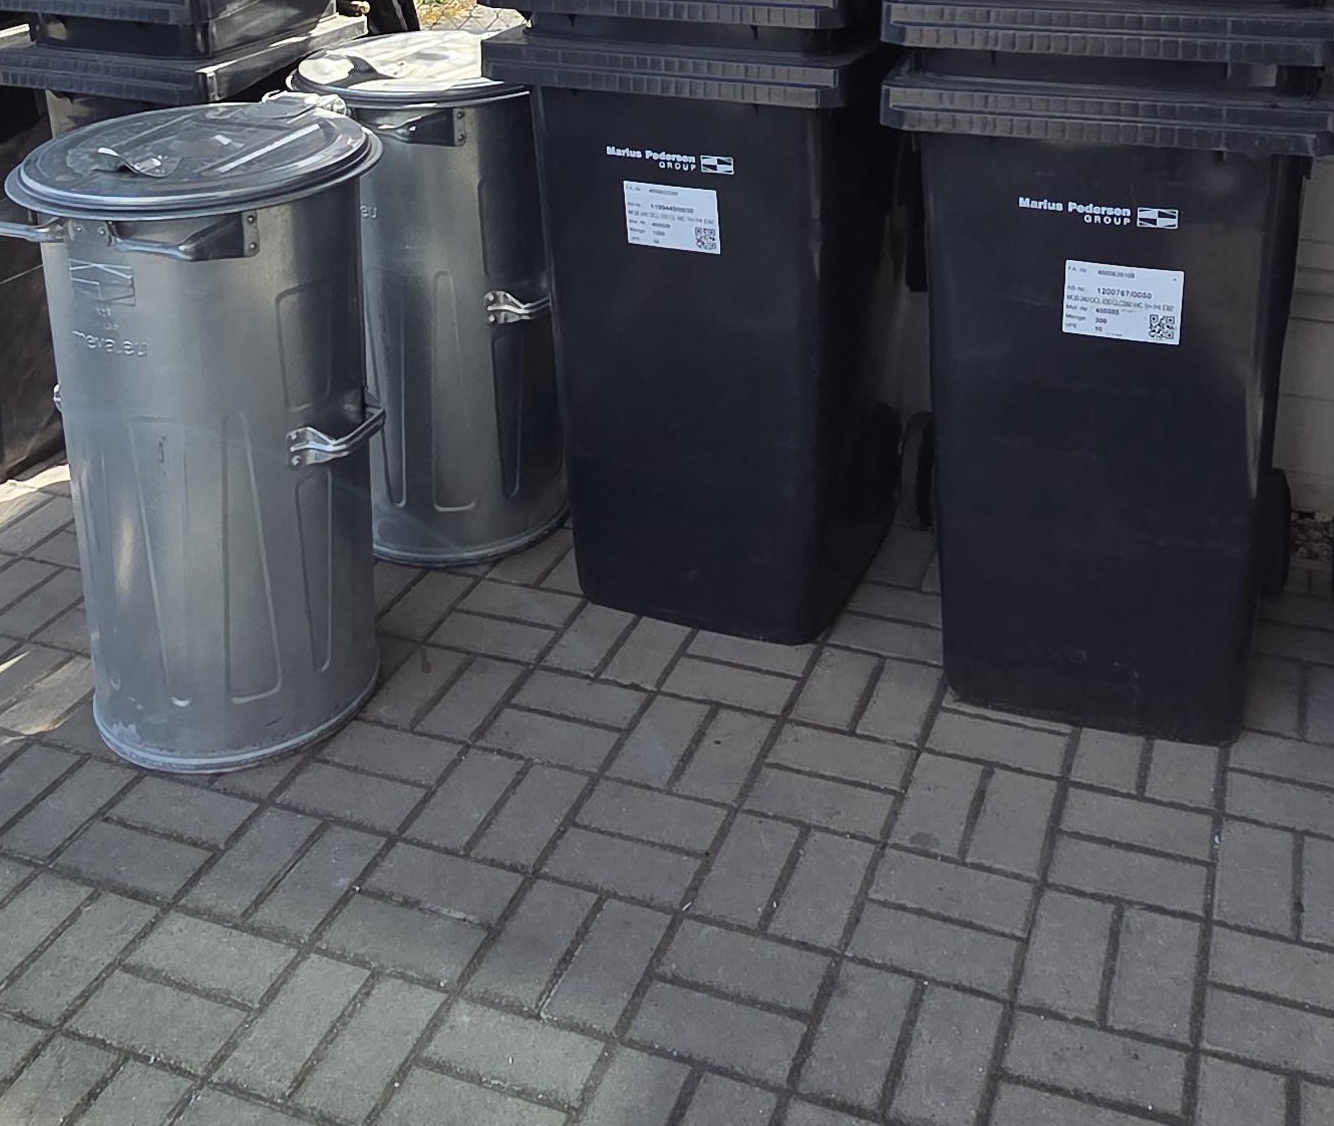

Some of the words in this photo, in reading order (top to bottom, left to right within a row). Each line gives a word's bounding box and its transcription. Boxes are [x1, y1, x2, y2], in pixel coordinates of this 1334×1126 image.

[606, 146, 642, 159] Marius
[645, 150, 695, 163] Pedersen
[659, 162, 697, 171] GROUP
[1018, 197, 1063, 212] Marius
[1068, 201, 1132, 217] Pedersen
[1084, 215, 1132, 226] GROUP
